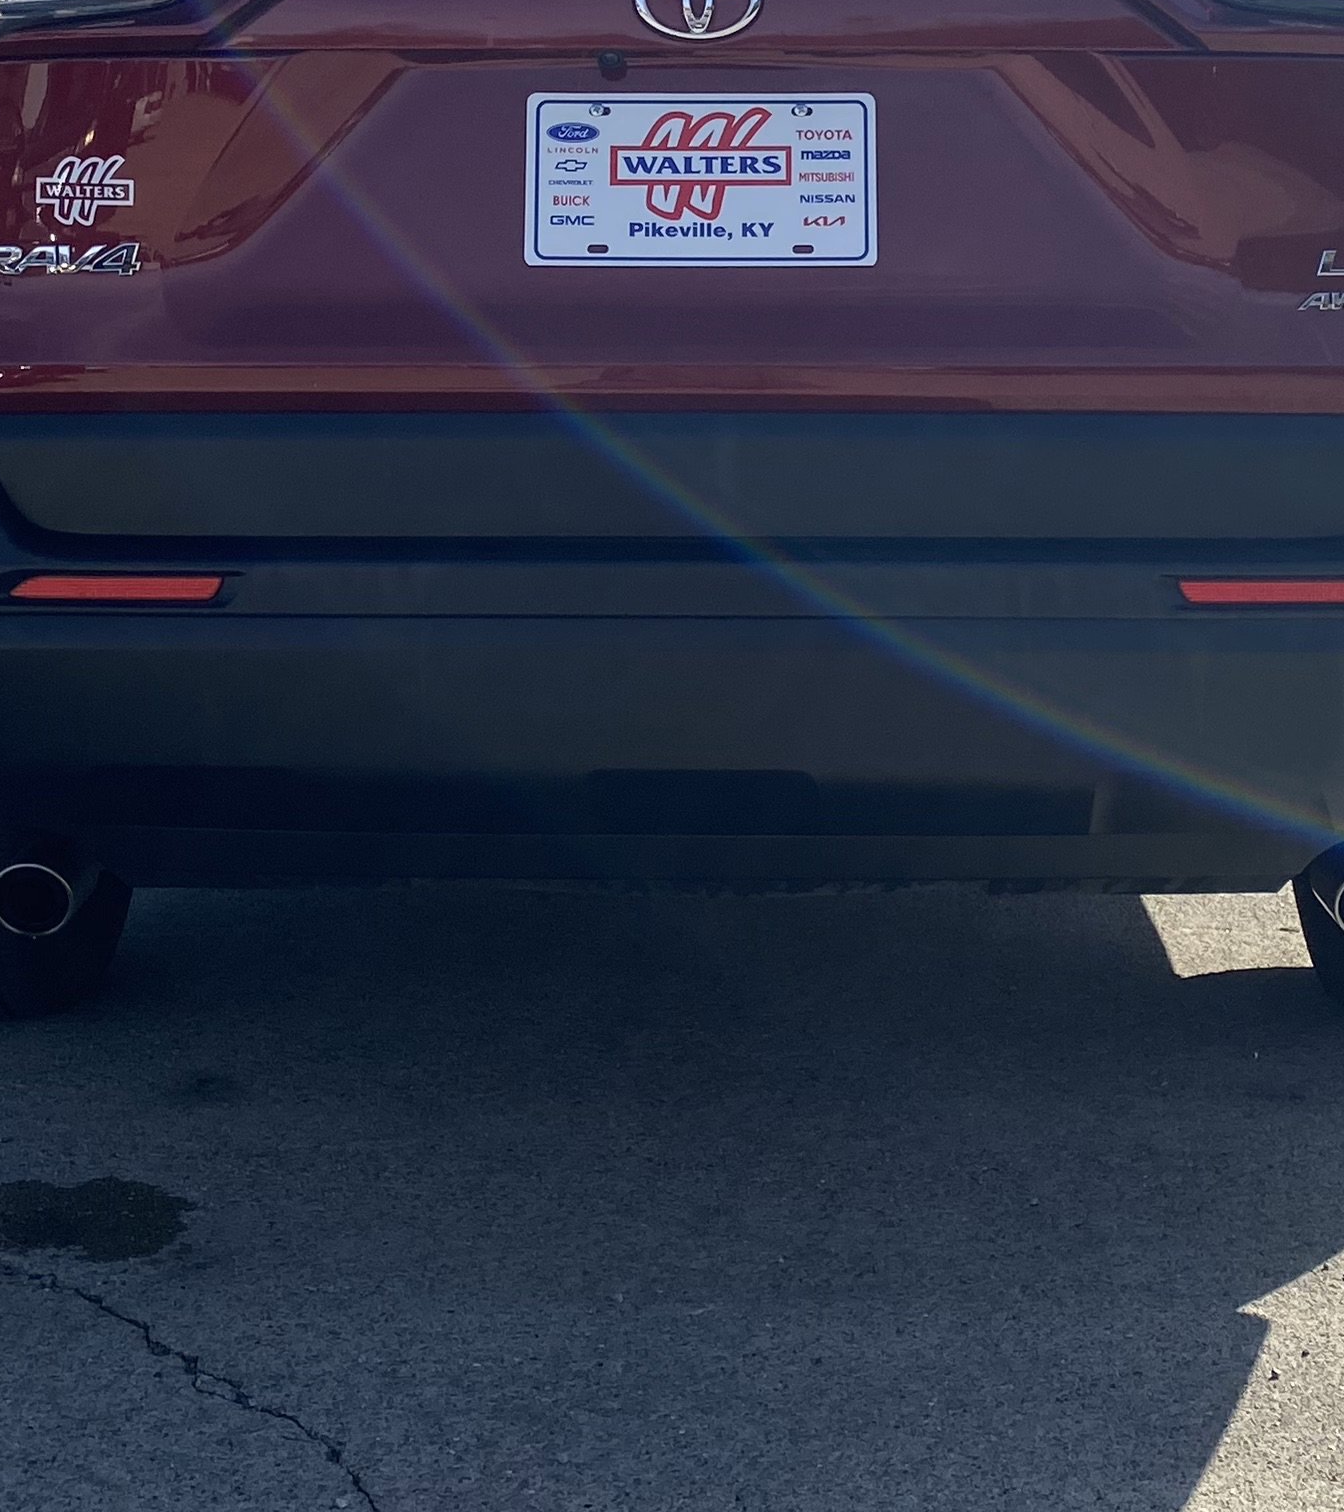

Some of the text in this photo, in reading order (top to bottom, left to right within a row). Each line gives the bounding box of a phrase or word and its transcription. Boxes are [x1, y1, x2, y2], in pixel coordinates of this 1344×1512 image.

[558, 125, 589, 138] Ford
[795, 129, 853, 141] TOYOTA
[622, 155, 783, 176] WALTERS
[799, 172, 855, 182] MITSUBISHI
[46, 184, 126, 198] WALTERS
[552, 195, 590, 207] BUICK
[799, 194, 856, 204] NISSAN
[550, 215, 595, 226] GMC
[629, 222, 775, 241] Pikeville, KY
